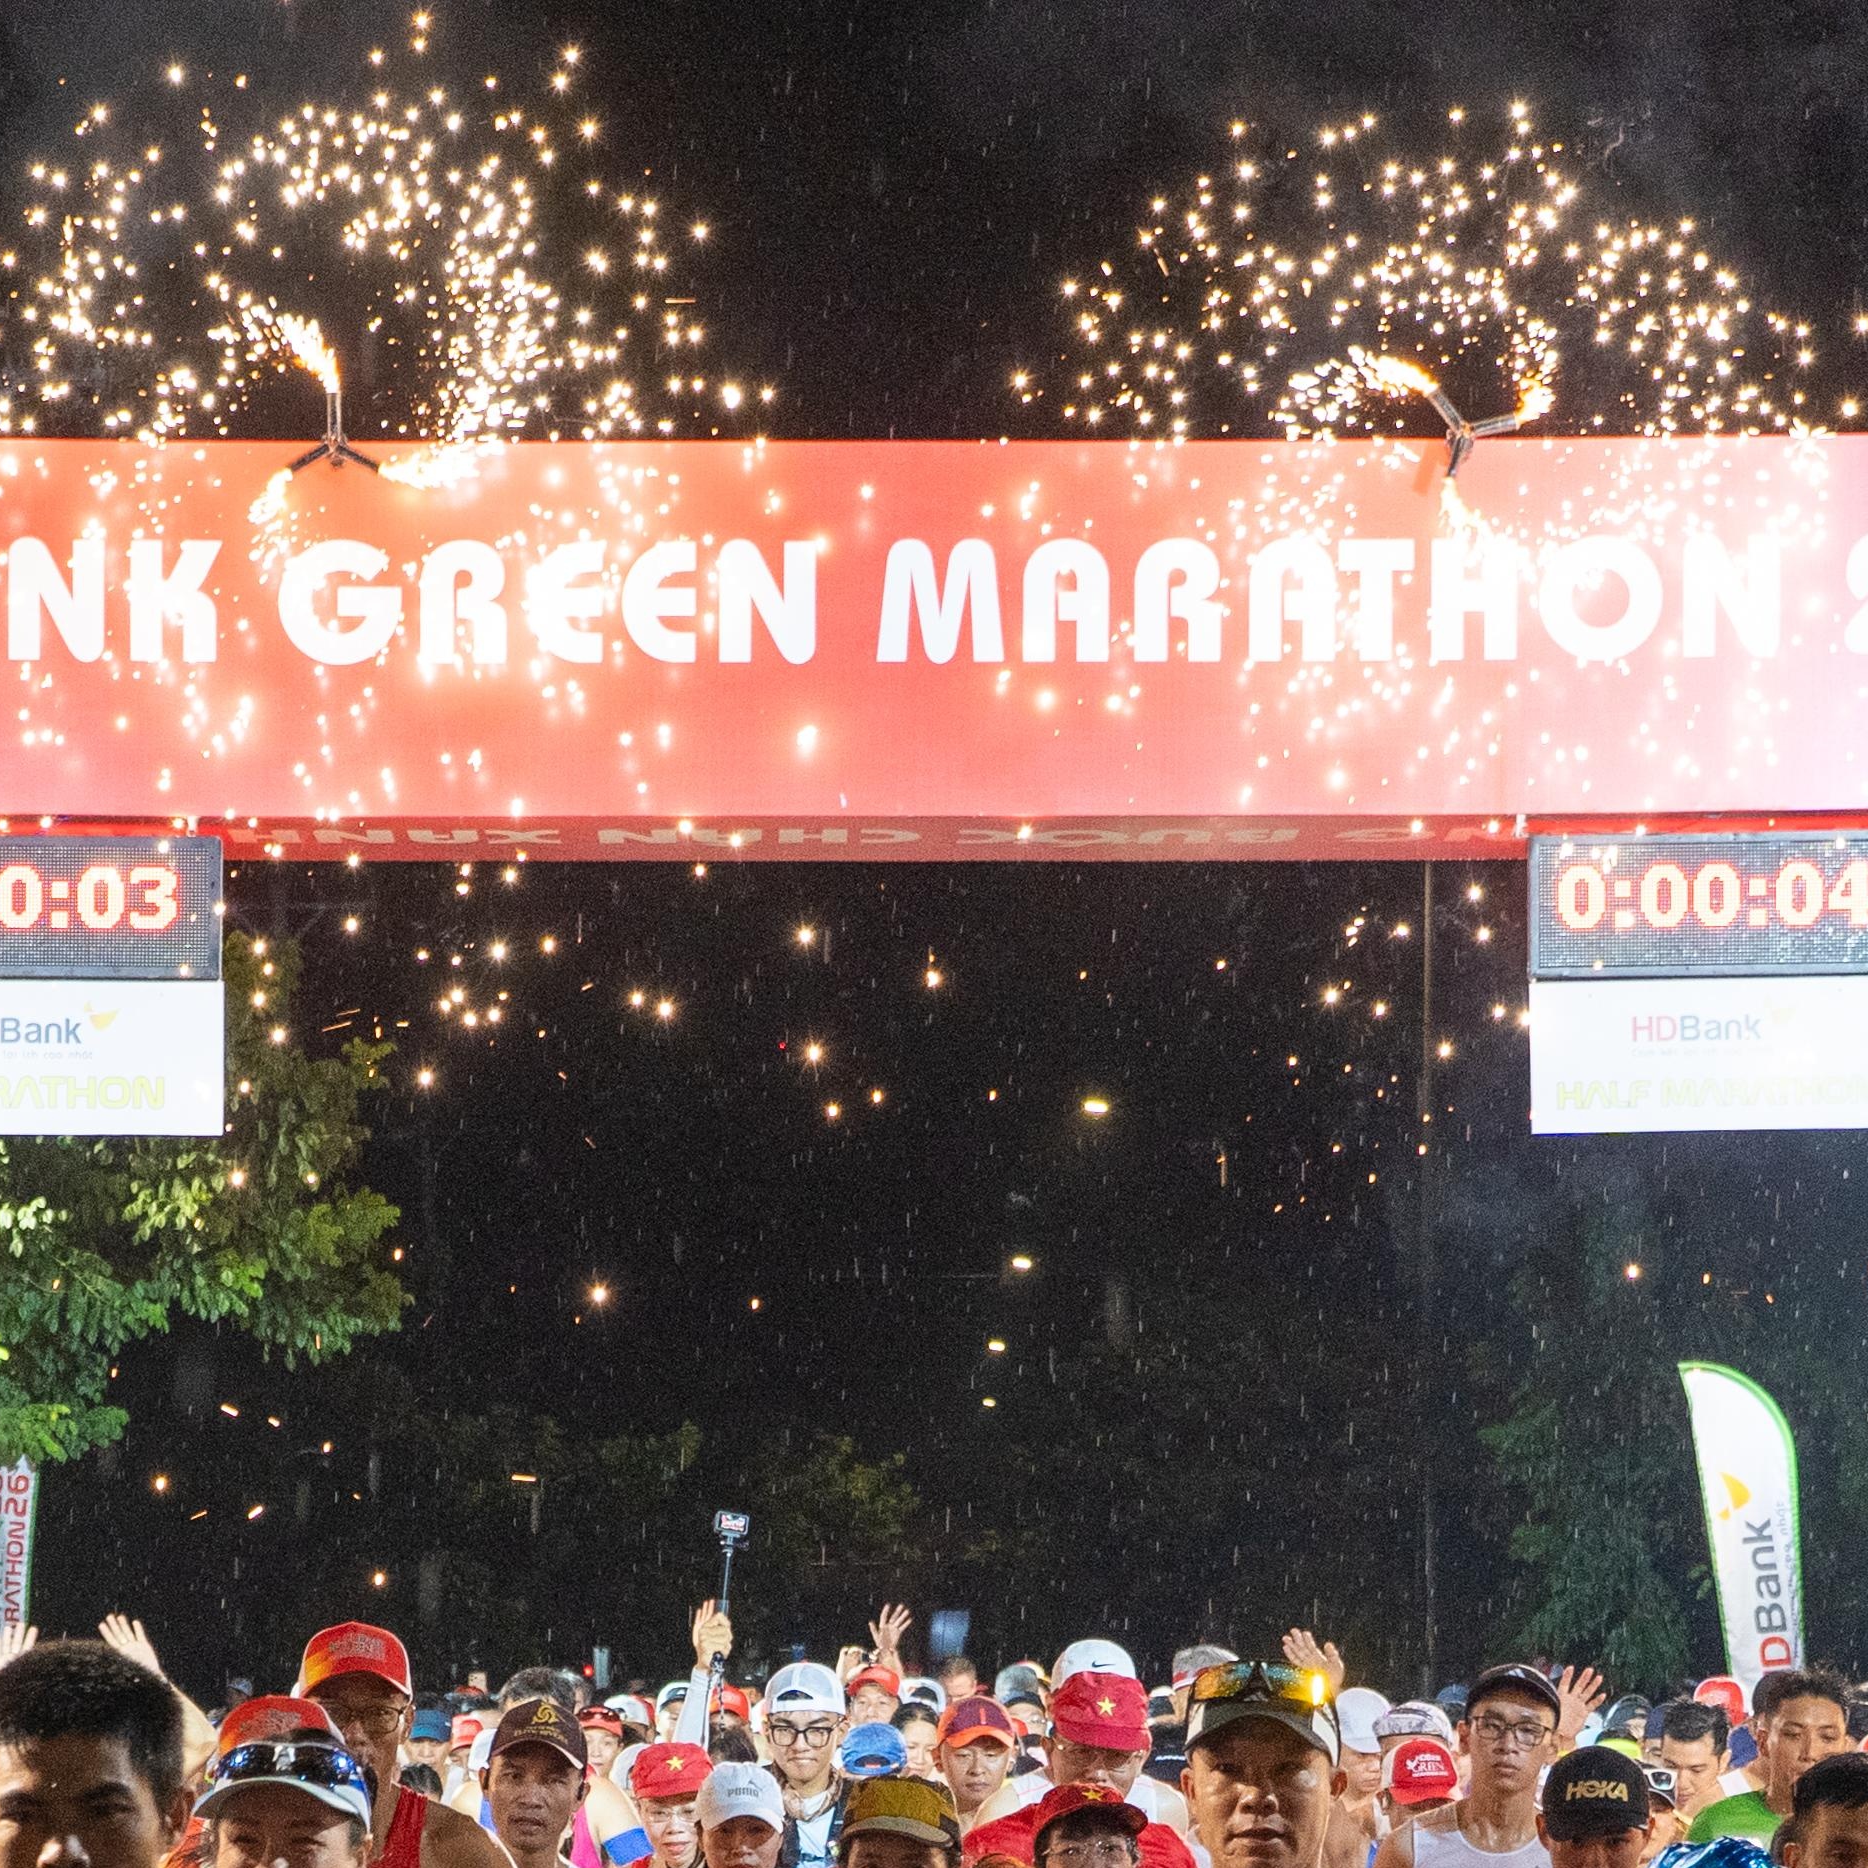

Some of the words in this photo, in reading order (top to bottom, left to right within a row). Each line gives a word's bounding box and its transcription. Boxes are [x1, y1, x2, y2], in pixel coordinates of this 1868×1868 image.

[277, 537, 820, 665] GREEN
[876, 535, 1782, 665] MARATHON
[1631, 1013, 1763, 1044] HDBank
[1555, 1080, 1653, 1111] HALF
[6, 1474, 31, 1519] 26
[4, 1526, 26, 1628] RATHON
[1565, 1779, 1629, 1803] HOKA
